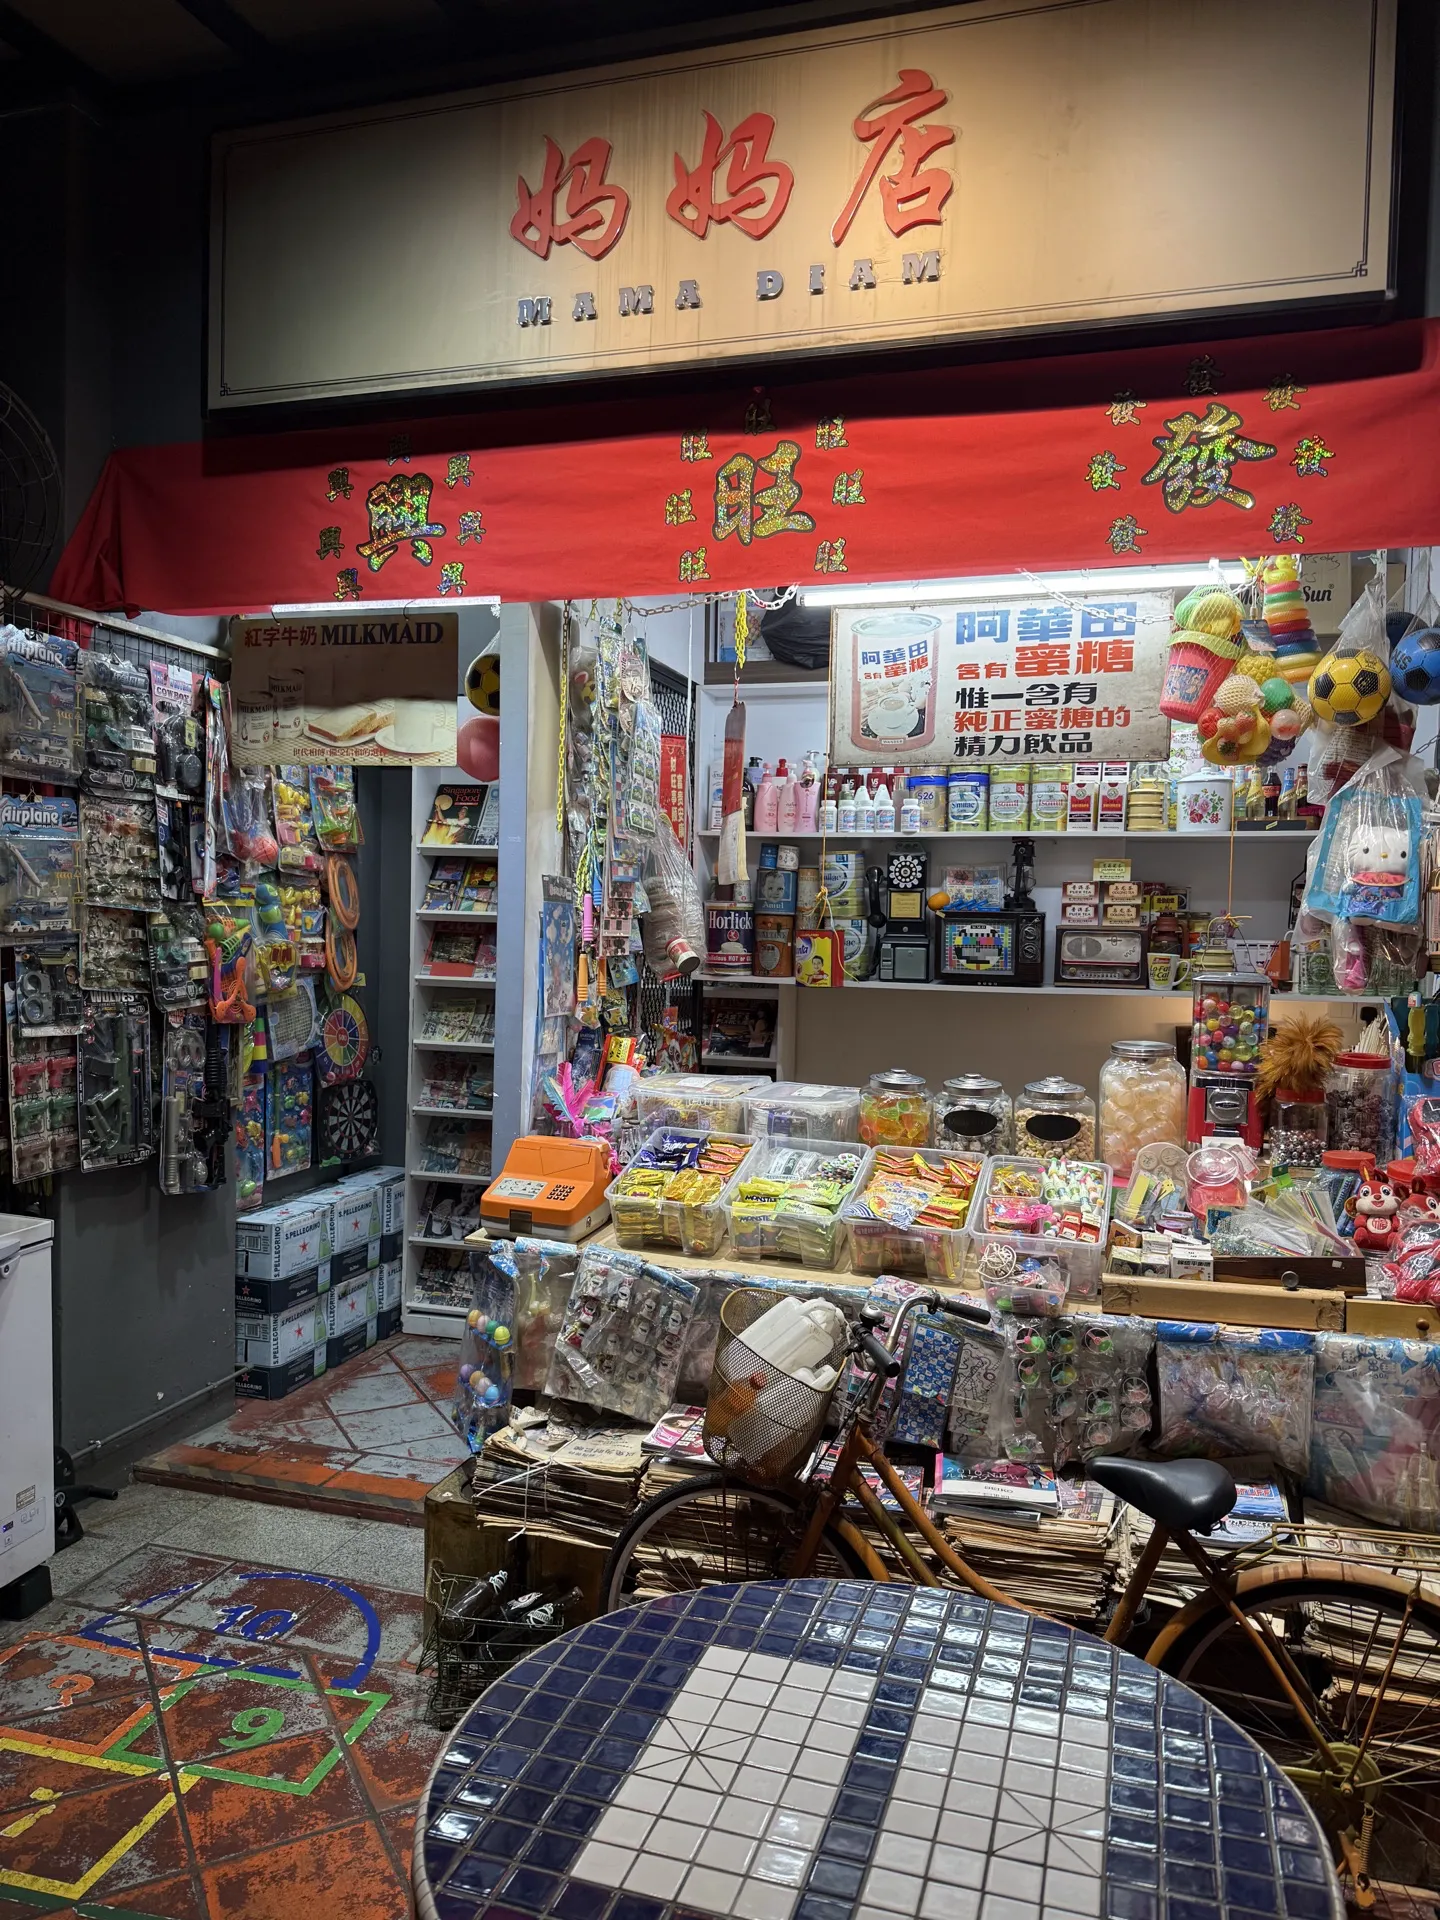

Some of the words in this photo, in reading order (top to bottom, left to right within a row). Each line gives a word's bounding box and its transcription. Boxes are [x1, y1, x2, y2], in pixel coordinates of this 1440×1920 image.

[508, 68, 956, 262] 妈妈店
[516, 279, 703, 328] MAMA
[756, 250, 942, 300] DIAM
[712, 440, 816, 546] 旺
[832, 468, 866, 507] 旺
[665, 488, 697, 526] 旺
[678, 546, 711, 583] 旺
[814, 537, 848, 574] 旺
[244, 626, 317, 648] 紅字牛奶
[320, 622, 444, 646] MILKMAID
[955, 601, 1138, 645] 阿華田
[861, 639, 929, 666] 阿華田
[954, 704, 1132, 734] 純正蜜糖的
[954, 732, 1094, 758] 精力飲品
[442, 786, 482, 796] Singapore
[456, 793, 481, 802] Food
[1, 805, 59, 826] Airplane
[338, 1201, 373, 1218] S.PELLEGRINO
[285, 1221, 321, 1241] S.PELLEGRINO
[273, 1226, 281, 1278] S.PELLEGRINO
[281, 1305, 316, 1327] S.PELLEGRINO
[211, 1604, 301, 1642] 10
[218, 1706, 285, 1748] 9
